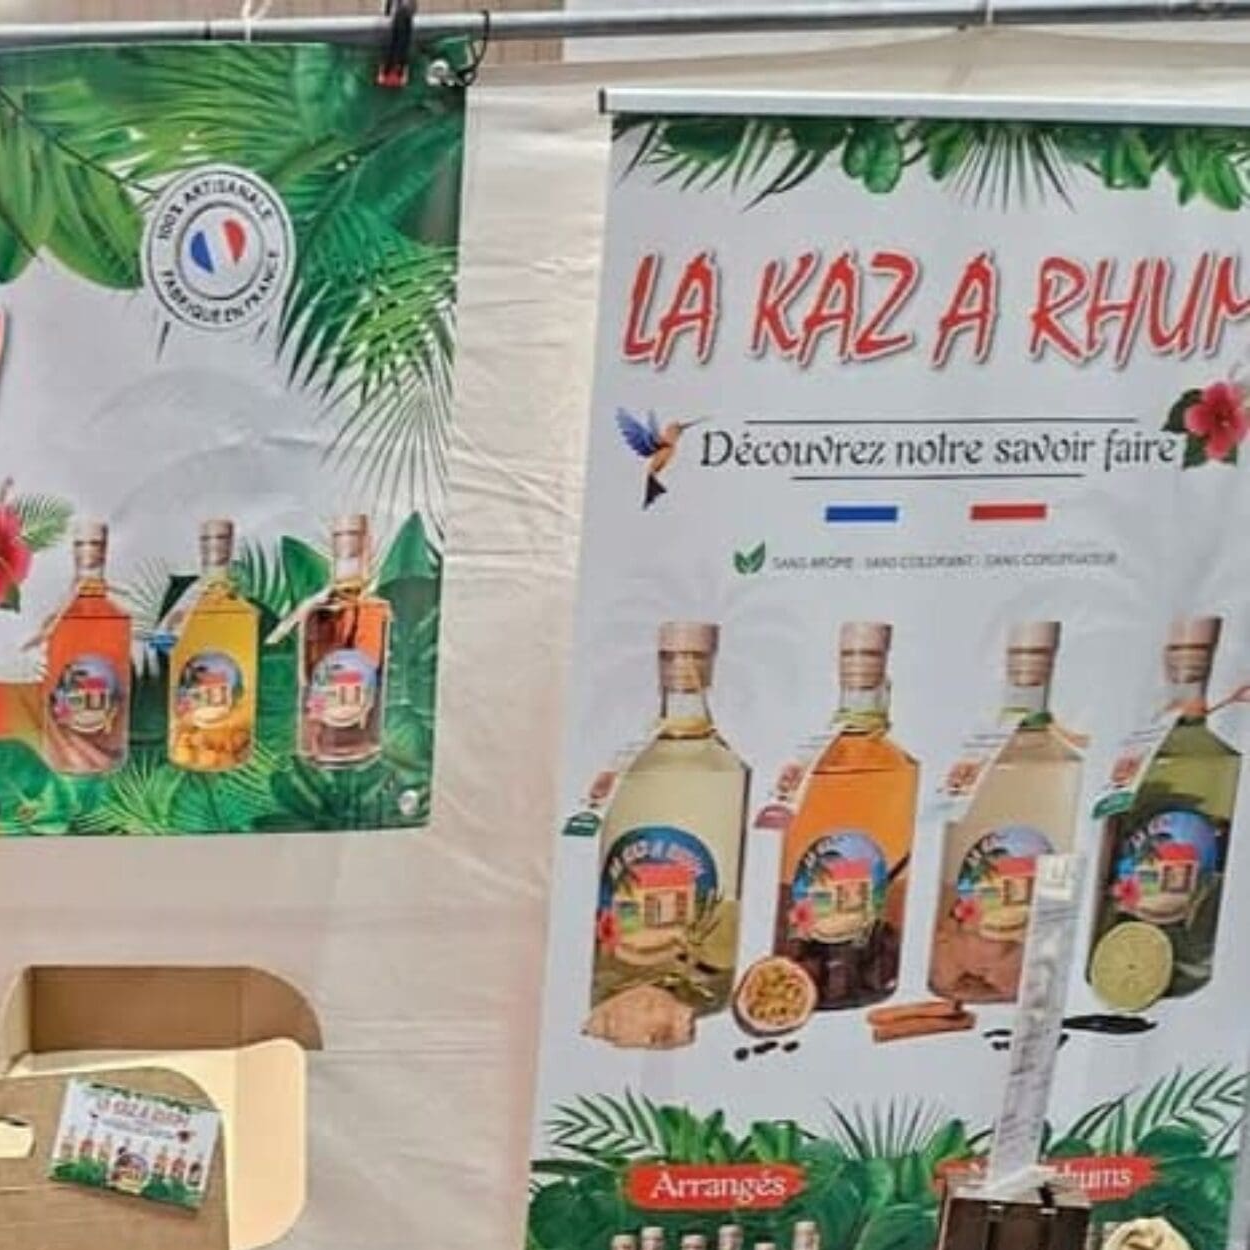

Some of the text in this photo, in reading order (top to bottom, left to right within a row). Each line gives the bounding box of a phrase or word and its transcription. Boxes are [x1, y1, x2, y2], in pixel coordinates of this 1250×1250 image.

[622, 248, 718, 371] LA
[750, 250, 916, 367] KAZ
[931, 251, 996, 368] A
[700, 427, 1177, 473] Découvrez notre savoir faire
[651, 1168, 787, 1206] Arrangés
